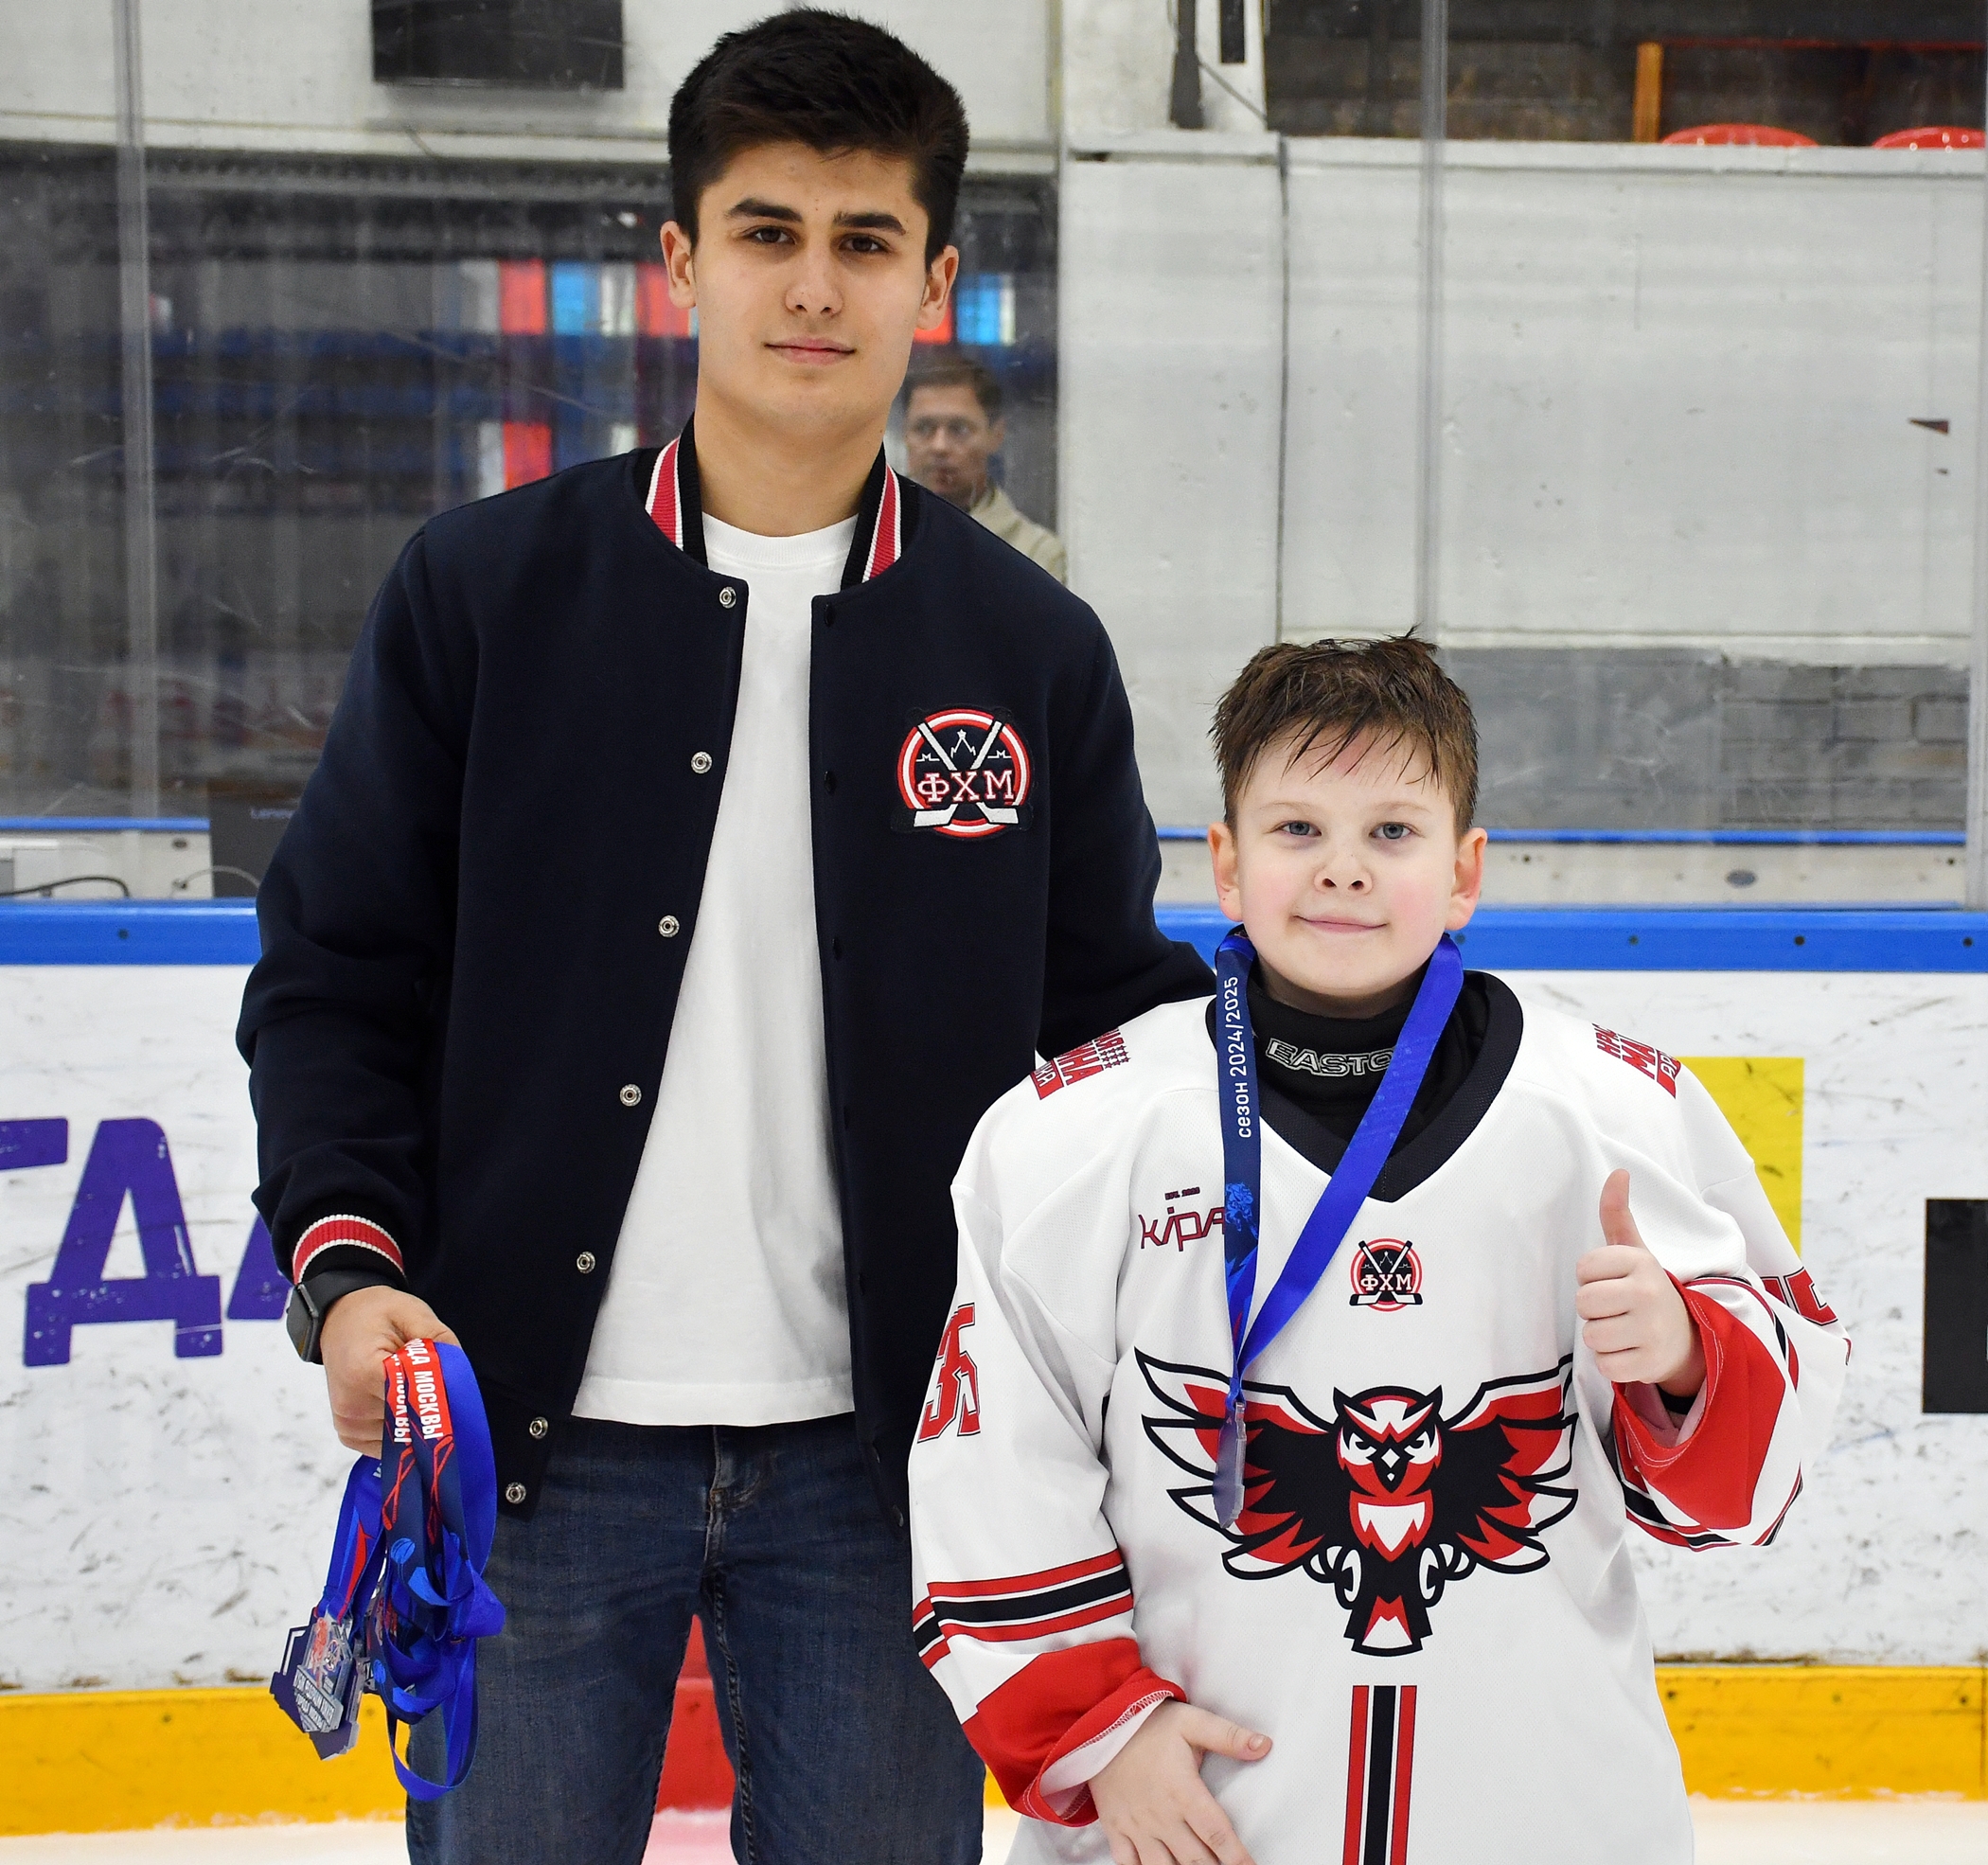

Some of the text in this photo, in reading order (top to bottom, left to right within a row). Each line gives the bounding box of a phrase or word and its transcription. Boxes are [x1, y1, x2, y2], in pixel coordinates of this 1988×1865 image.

[916, 770, 1015, 803] ФХМ
[1224, 976, 1251, 1138] сезон 2024/2025
[1360, 1273, 1411, 1291] ФХМ
[414, 1370, 444, 1440] МОСКВЫ
